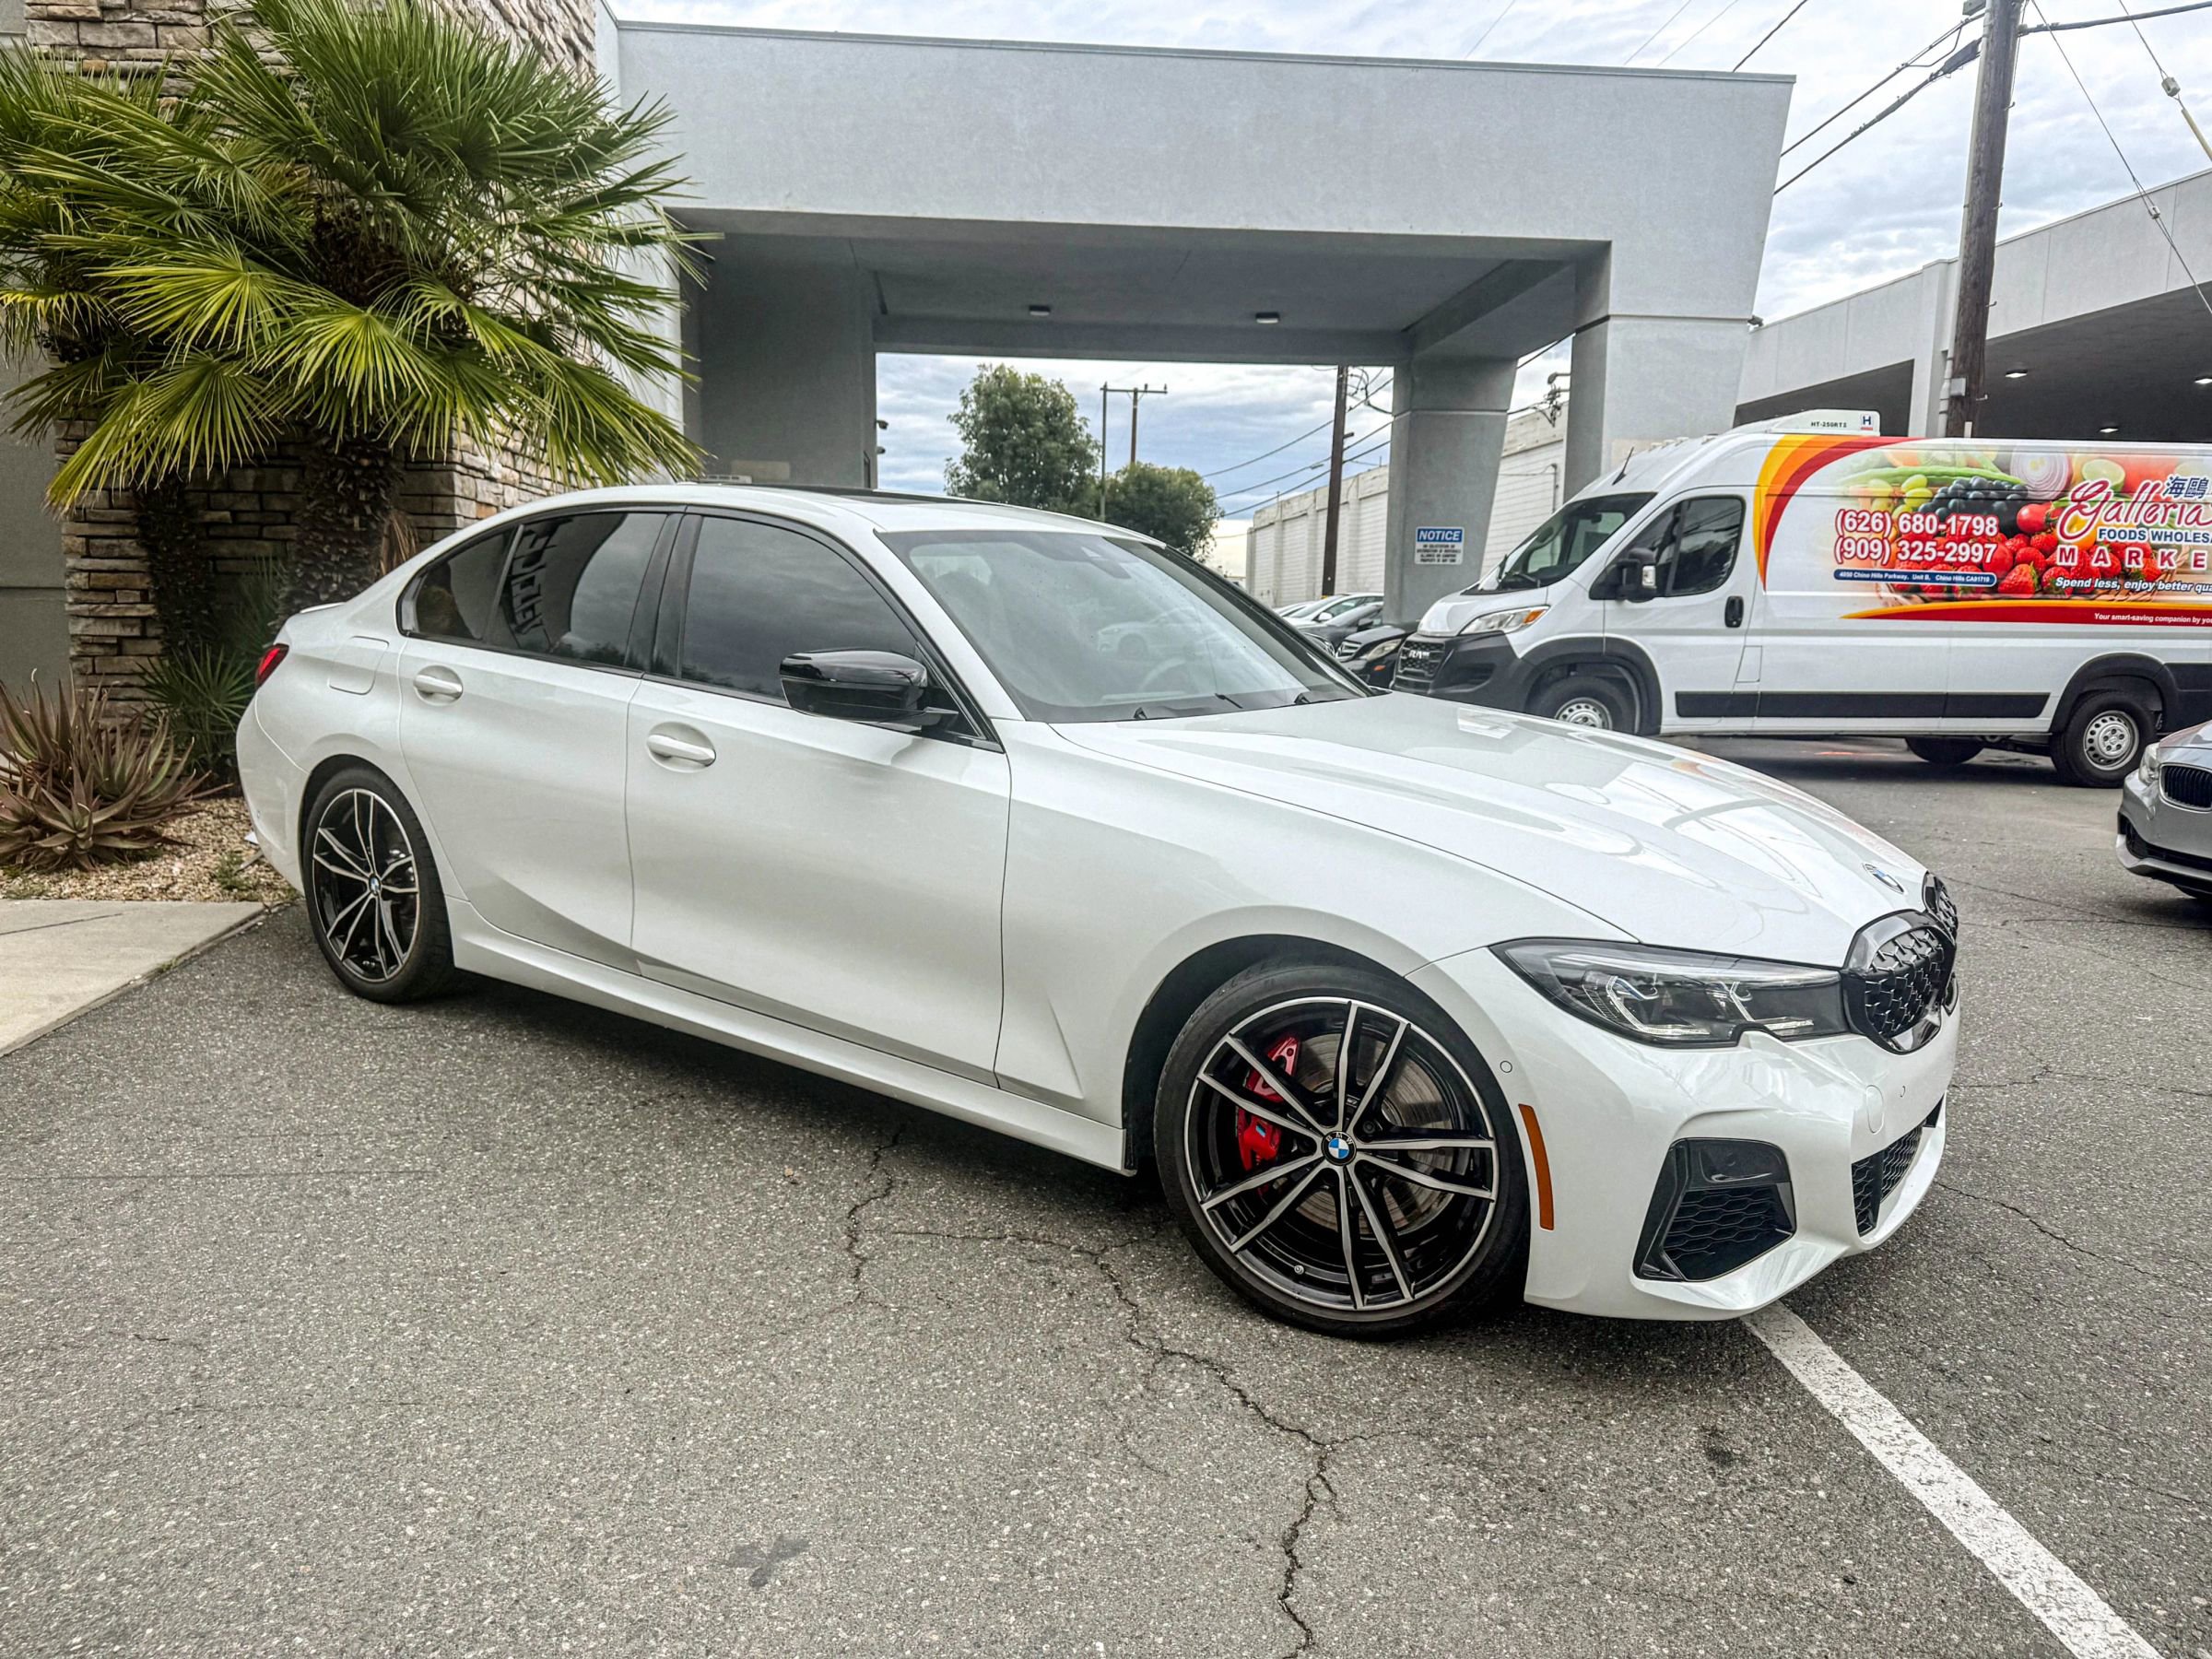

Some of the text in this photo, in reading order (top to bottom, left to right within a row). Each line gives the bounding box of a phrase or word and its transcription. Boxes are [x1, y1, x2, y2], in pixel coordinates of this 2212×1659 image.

[1835, 509, 1999, 536] (626) 680-1798
[1419, 530, 1461, 541] NOTICE
[2099, 528, 2212, 544] FOODS WHOLES
[1834, 536, 1998, 566] (909) 325-2997
[2055, 576, 2092, 589] Spend
[2093, 578, 2121, 590] less,
[2124, 580, 2155, 593] enjoy
[2158, 581, 2193, 592] better
[2094, 612, 2111, 621] Your
[2155, 616, 2191, 624] companion
[2192, 617, 2201, 625] by
